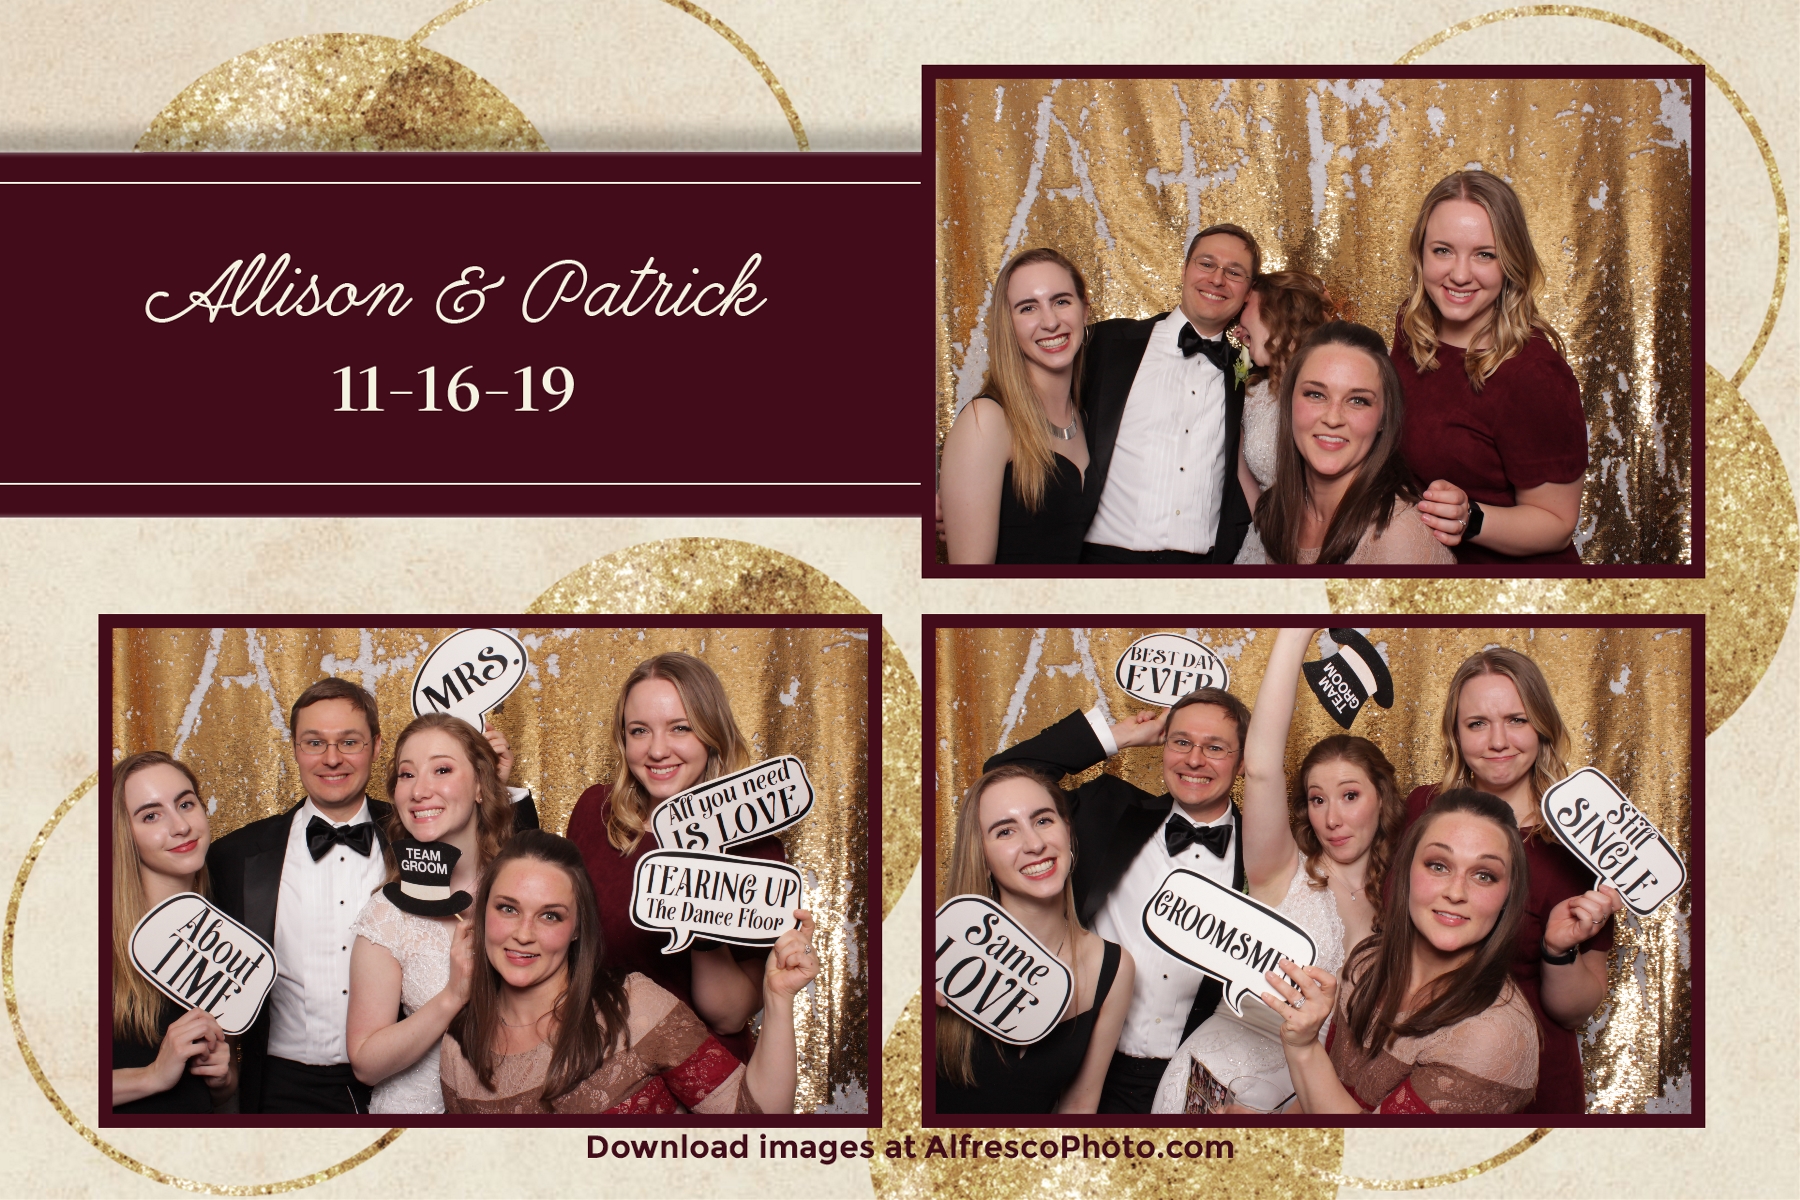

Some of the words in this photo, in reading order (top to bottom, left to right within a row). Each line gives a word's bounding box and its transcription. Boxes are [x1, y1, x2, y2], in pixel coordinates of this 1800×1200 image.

[420, 646, 520, 714] MRS.
[1130, 646, 1180, 666] BEST
[1182, 652, 1218, 671] DAY
[1318, 676, 1347, 714] TEAM
[1323, 661, 1360, 709] GROOM
[667, 793, 696, 826] All
[698, 785, 737, 820] you
[742, 758, 791, 796] need
[672, 822, 710, 851] IS
[714, 784, 801, 844] LOVE
[1606, 802, 1659, 851] Still
[401, 859, 448, 875] GROOM
[405, 847, 441, 862] TEAM
[1557, 797, 1659, 903] SINGLE
[644, 863, 758, 905] TEARING
[764, 876, 798, 908] UP
[646, 897, 677, 921] The
[680, 901, 734, 927] Dance
[737, 907, 785, 931] Floor
[176, 906, 266, 986] About
[964, 912, 1050, 986] Same
[151, 932, 242, 1020] TIME
